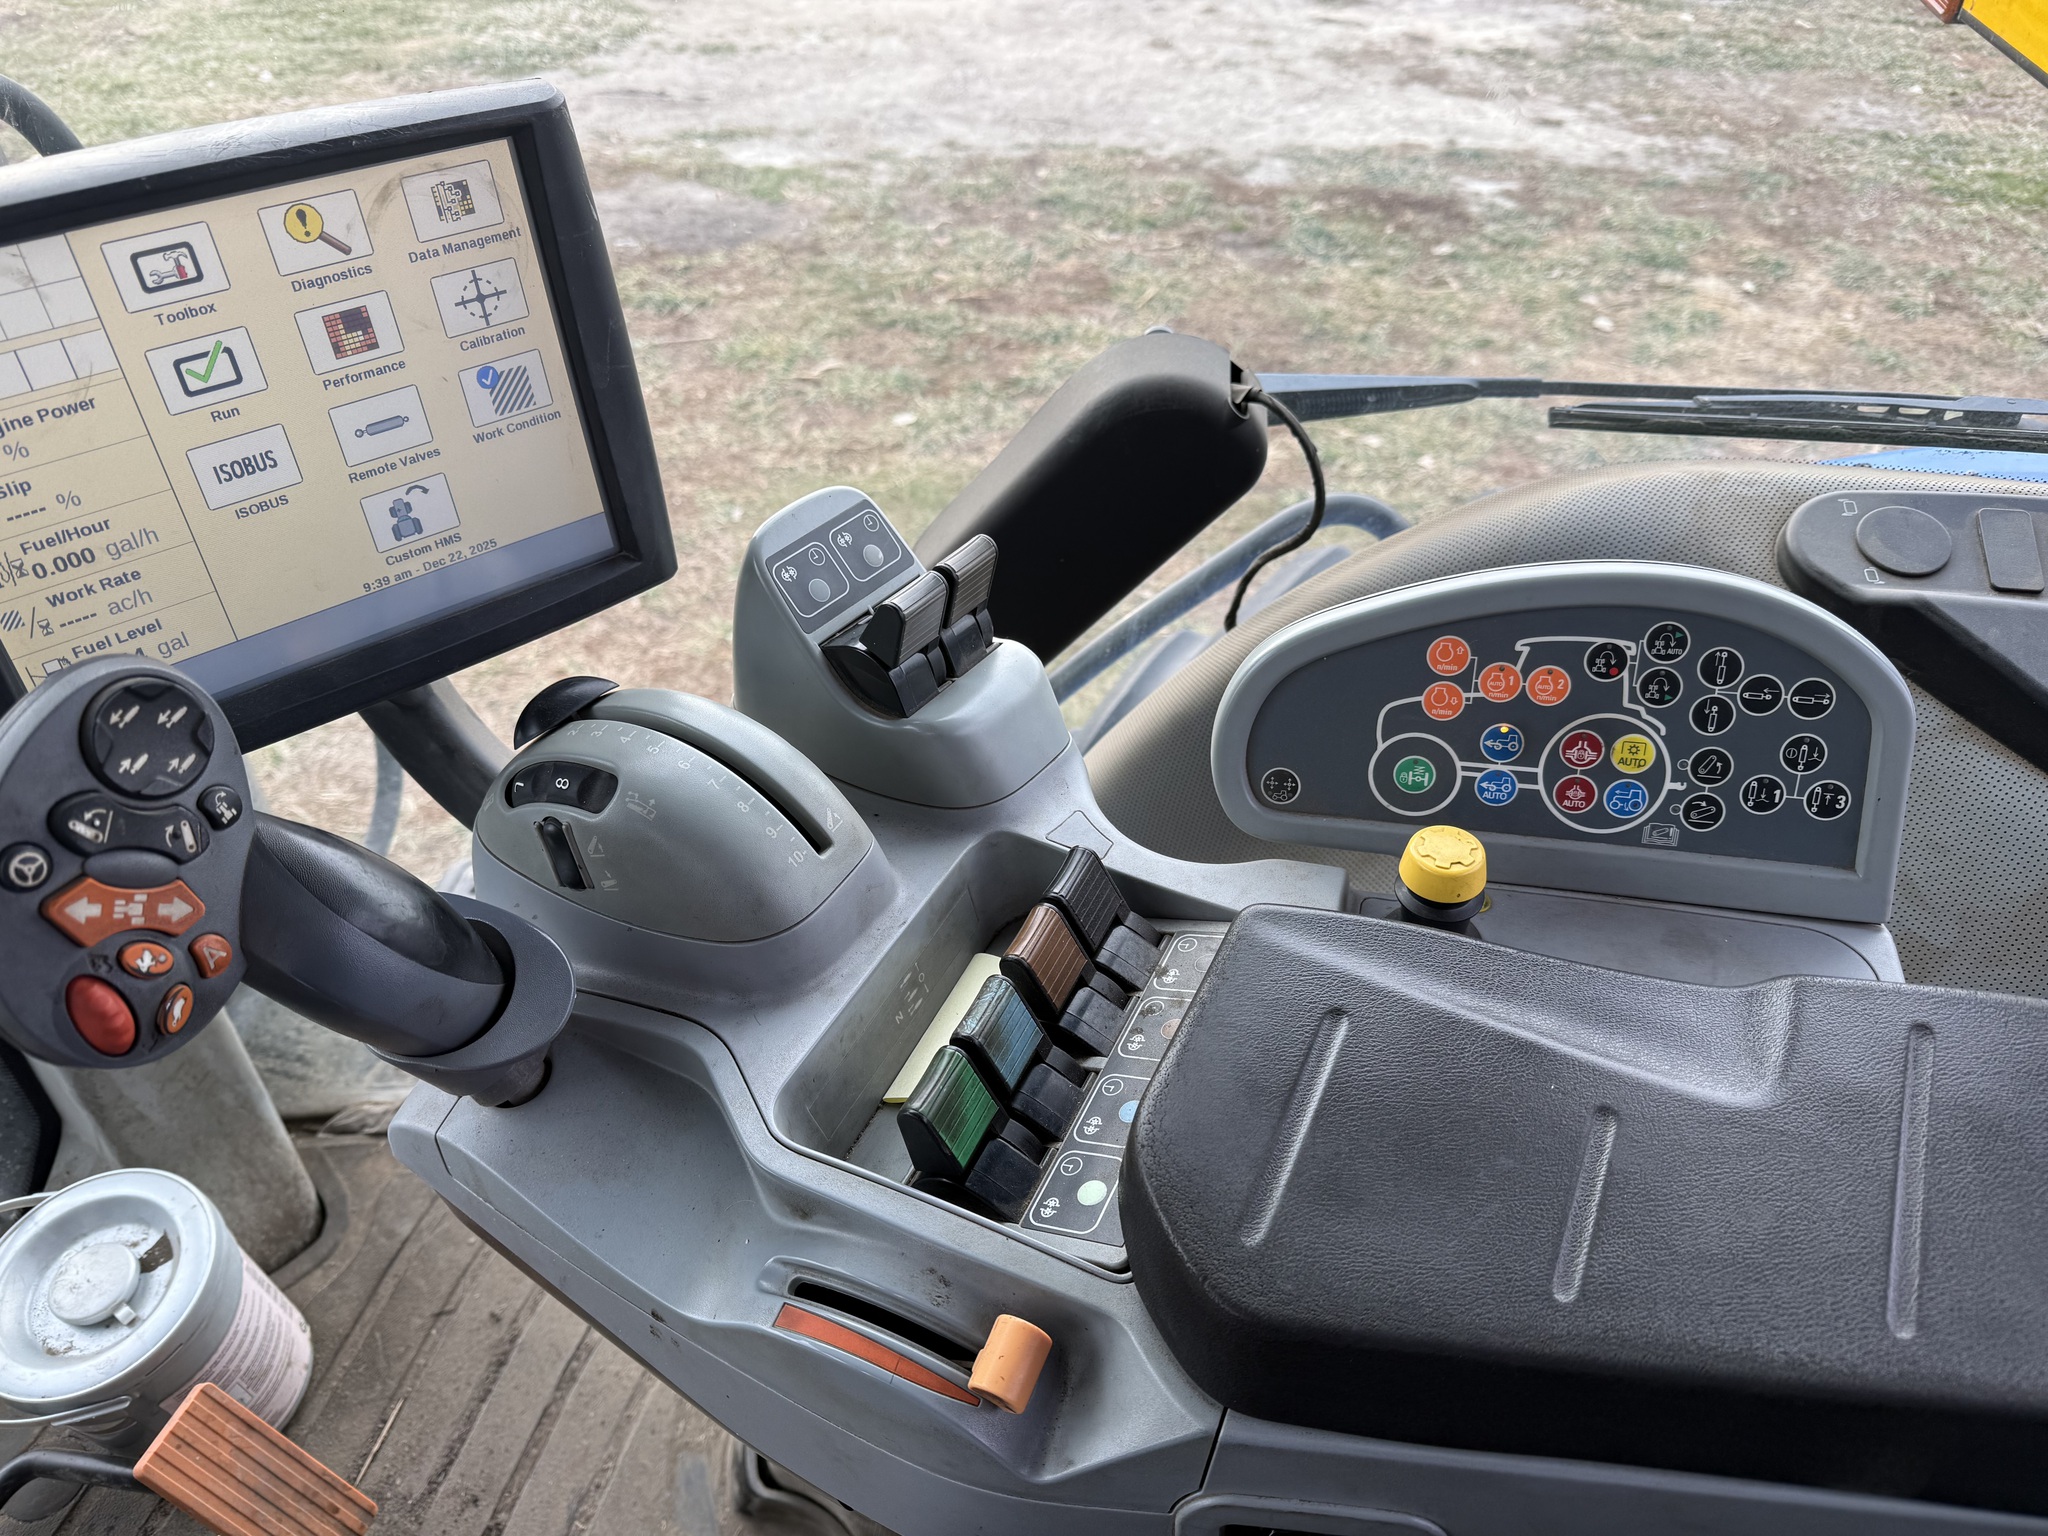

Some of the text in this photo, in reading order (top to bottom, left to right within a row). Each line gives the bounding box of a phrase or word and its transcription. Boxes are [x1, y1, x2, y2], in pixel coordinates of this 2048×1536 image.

[408, 226, 522, 264] Data Management
[291, 264, 373, 292] Diagnostics
[154, 302, 217, 326] Toolbox
[459, 325, 525, 351] Calibration
[322, 360, 406, 391] Performance
[36, 397, 95, 423] Power
[210, 406, 241, 423] Run
[472, 409, 562, 444] Work Condition
[2, 441, 30, 461] %
[212, 450, 278, 485] ISOBUS
[348, 448, 441, 484] Remote Valves
[55, 490, 82, 510] %
[234, 494, 290, 520] ISOBUS
[19, 517, 111, 555] Fuel/Hour
[31, 526, 160, 580] 0.000 gal/h
[385, 532, 463, 567] Custom HMS
[362, 575, 391, 593] 9:39
[394, 569, 413, 583] am
[422, 557, 446, 573] Dec
[447, 549, 468, 564] 22,
[469, 538, 498, 556] 2025
[45, 568, 142, 608] Work Rate
[107, 588, 154, 616] ac/h
[71, 635, 113, 659] Fuel
[114, 618, 163, 644] Level
[157, 631, 190, 659] gal
[1666, 647, 1683, 656] AUTO
[1436, 663, 1458, 672] n/min
[1508, 675, 1515, 686] 1
[1557, 679, 1565, 690] 2
[1488, 691, 1509, 699] n/min
[1536, 694, 1557, 702] n/min
[1431, 708, 1453, 716] n/min
[647, 745, 660, 755] 5
[677, 760, 691, 770] 6
[1617, 756, 1648, 769] AUTO
[555, 777, 570, 790] 8
[707, 778, 720, 790] 7
[1482, 790, 1508, 801] AUTO
[1562, 799, 1586, 809] AUTO
[1772, 788, 1782, 804] 1
[1834, 794, 1846, 809] 3
[737, 801, 750, 813] 8
[765, 826, 778, 839] 9
[788, 850, 804, 868] 10
[202, 945, 228, 971] A
